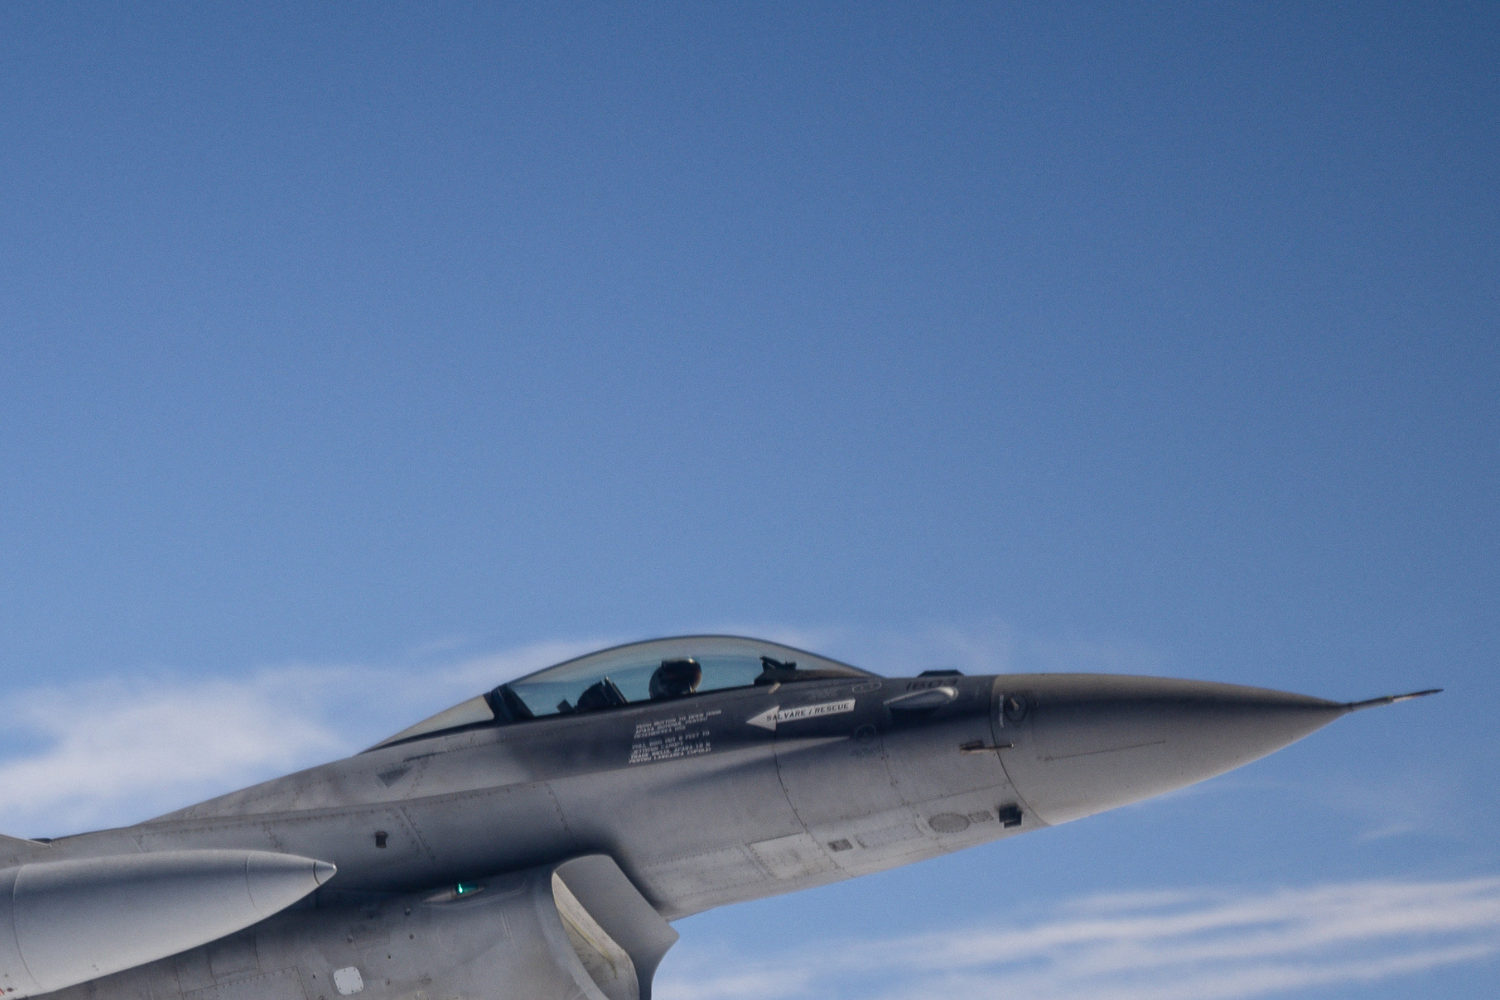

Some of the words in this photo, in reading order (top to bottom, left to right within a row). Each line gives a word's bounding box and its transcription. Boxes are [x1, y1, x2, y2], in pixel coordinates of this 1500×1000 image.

[766, 709, 805, 722] SALVARE
[808, 708, 812, 716] /
[814, 702, 850, 714] RESCUE
